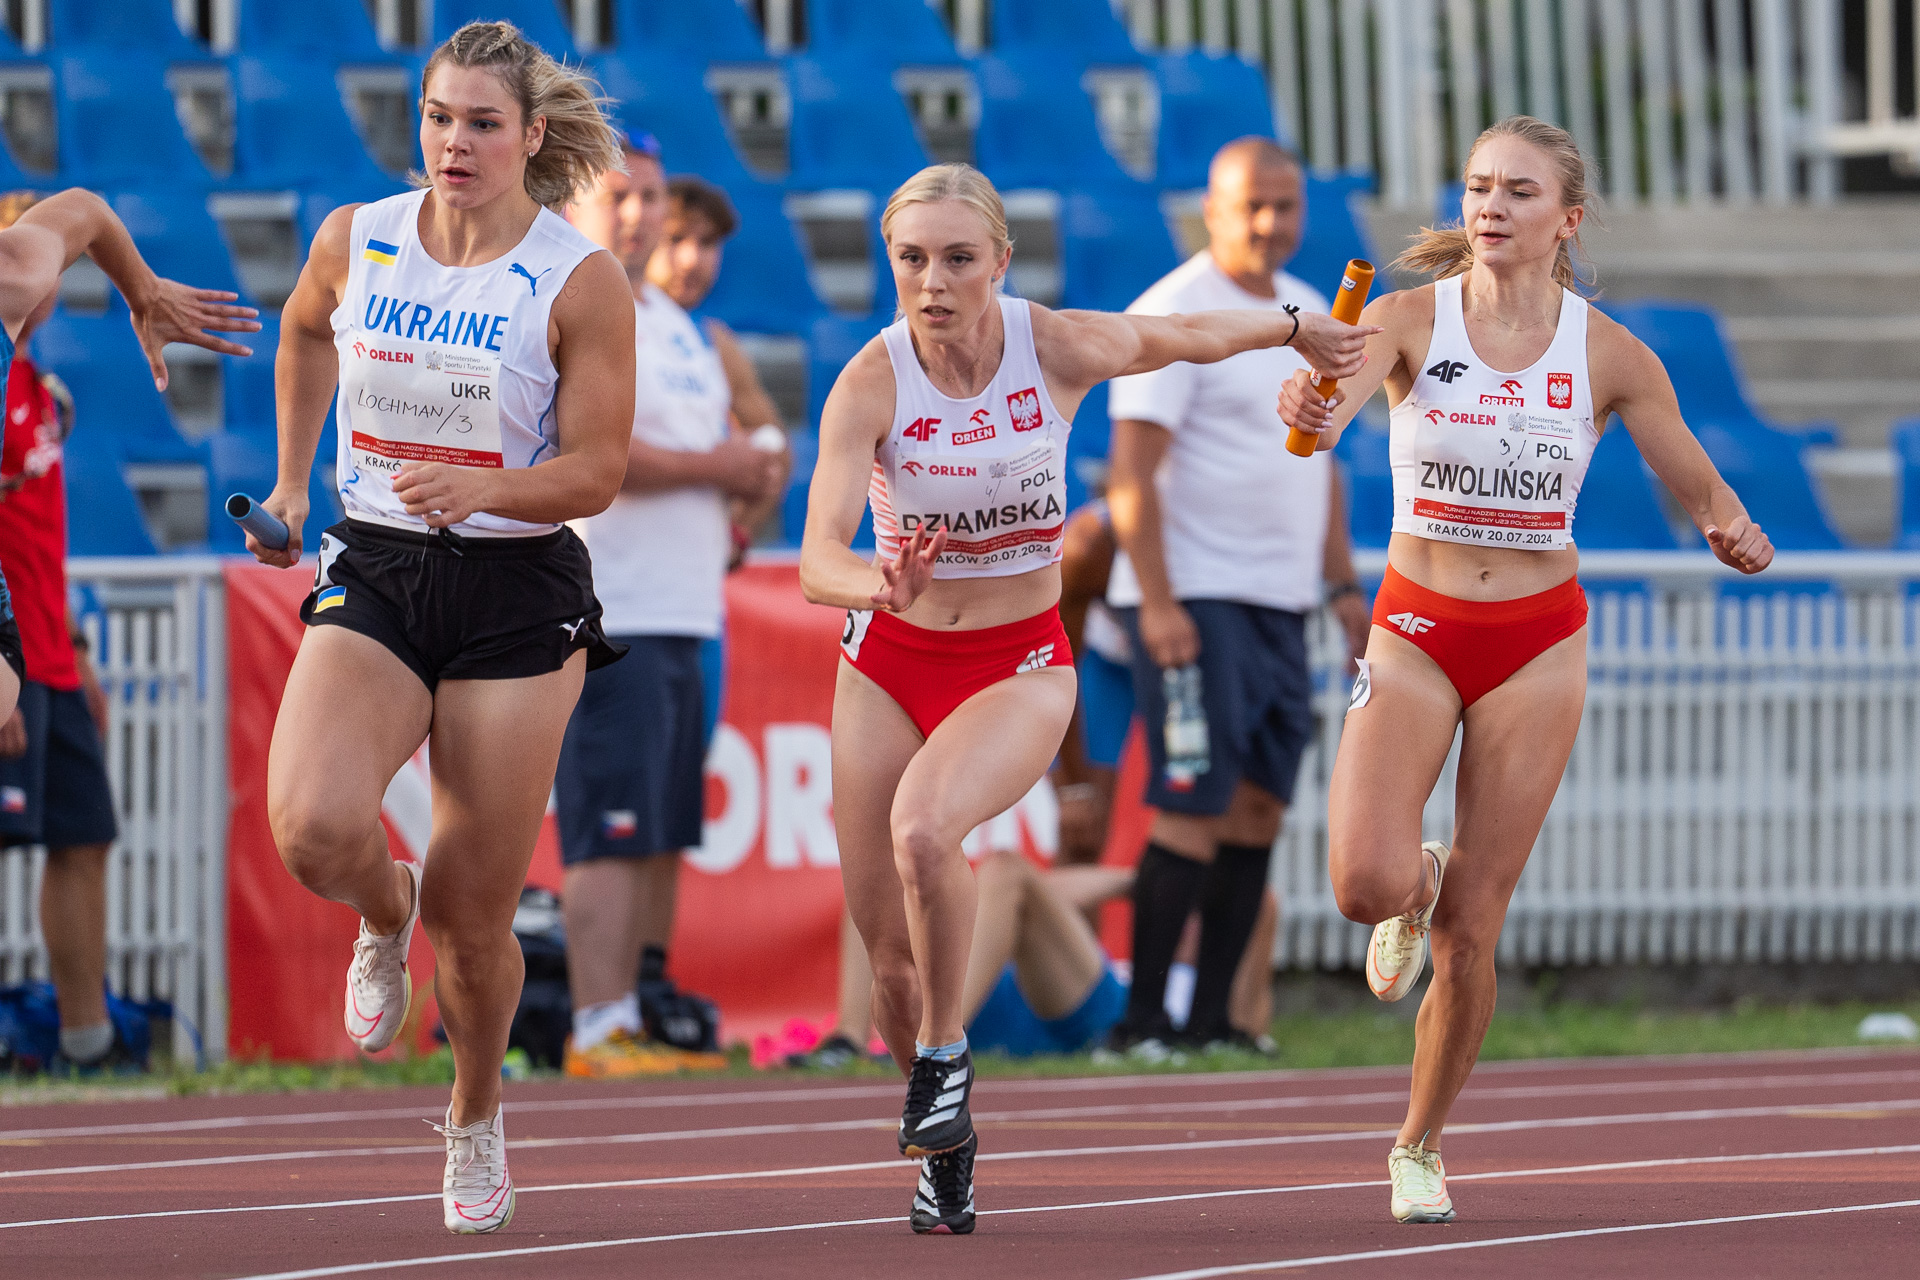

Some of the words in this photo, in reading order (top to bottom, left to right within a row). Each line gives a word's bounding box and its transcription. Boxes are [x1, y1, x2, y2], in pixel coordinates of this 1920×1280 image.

[364, 294, 509, 352] UKRAINE
[369, 349, 414, 363] ORLEN
[445, 354, 481, 363] Ministerstwo
[444, 361, 462, 370] Sportu
[467, 363, 492, 372] Turystyki
[1426, 359, 1470, 384] 4F
[451, 382, 491, 401] UKR
[1481, 396, 1522, 407] ORLEN
[1449, 412, 1496, 426] ORLEN
[1528, 415, 1563, 425] Ministerstwo
[903, 417, 942, 441] 4F
[954, 429, 994, 444] ORLEN
[1528, 423, 1546, 431] Sportu
[1550, 425, 1573, 434] Turystyki
[354, 440, 370, 449] MECZ
[370, 444, 424, 458] LEKKOATLETYCZNY
[375, 440, 400, 449] TURNIEJ
[400, 444, 426, 452] NADZIEI
[426, 446, 469, 457] OLIMPIJSKICH
[1009, 448, 1041, 465] Ministerstwo
[1536, 442, 1574, 461] POL
[365, 455, 402, 471] KRAKÓ
[929, 465, 977, 476] ORLEN
[1020, 468, 1056, 492] POL
[1420, 461, 1563, 501] ZWOLIŃSKA
[902, 493, 1061, 534] DZIAMSKA
[1417, 508, 1434, 516] MECZ
[1434, 511, 1494, 523] LEKKOATLETYCZNY
[1443, 505, 1470, 515] TURNIEJ
[1497, 512, 1541, 520] OLIMPIJSKICH
[1427, 522, 1484, 539] KRAKÓW
[1487, 530, 1553, 544] 20.07.2024
[935, 552, 979, 564] AKÓW
[983, 544, 1052, 565] 20.07.2024
[1386, 612, 1436, 635] 4F
[1016, 643, 1055, 674] 4F
